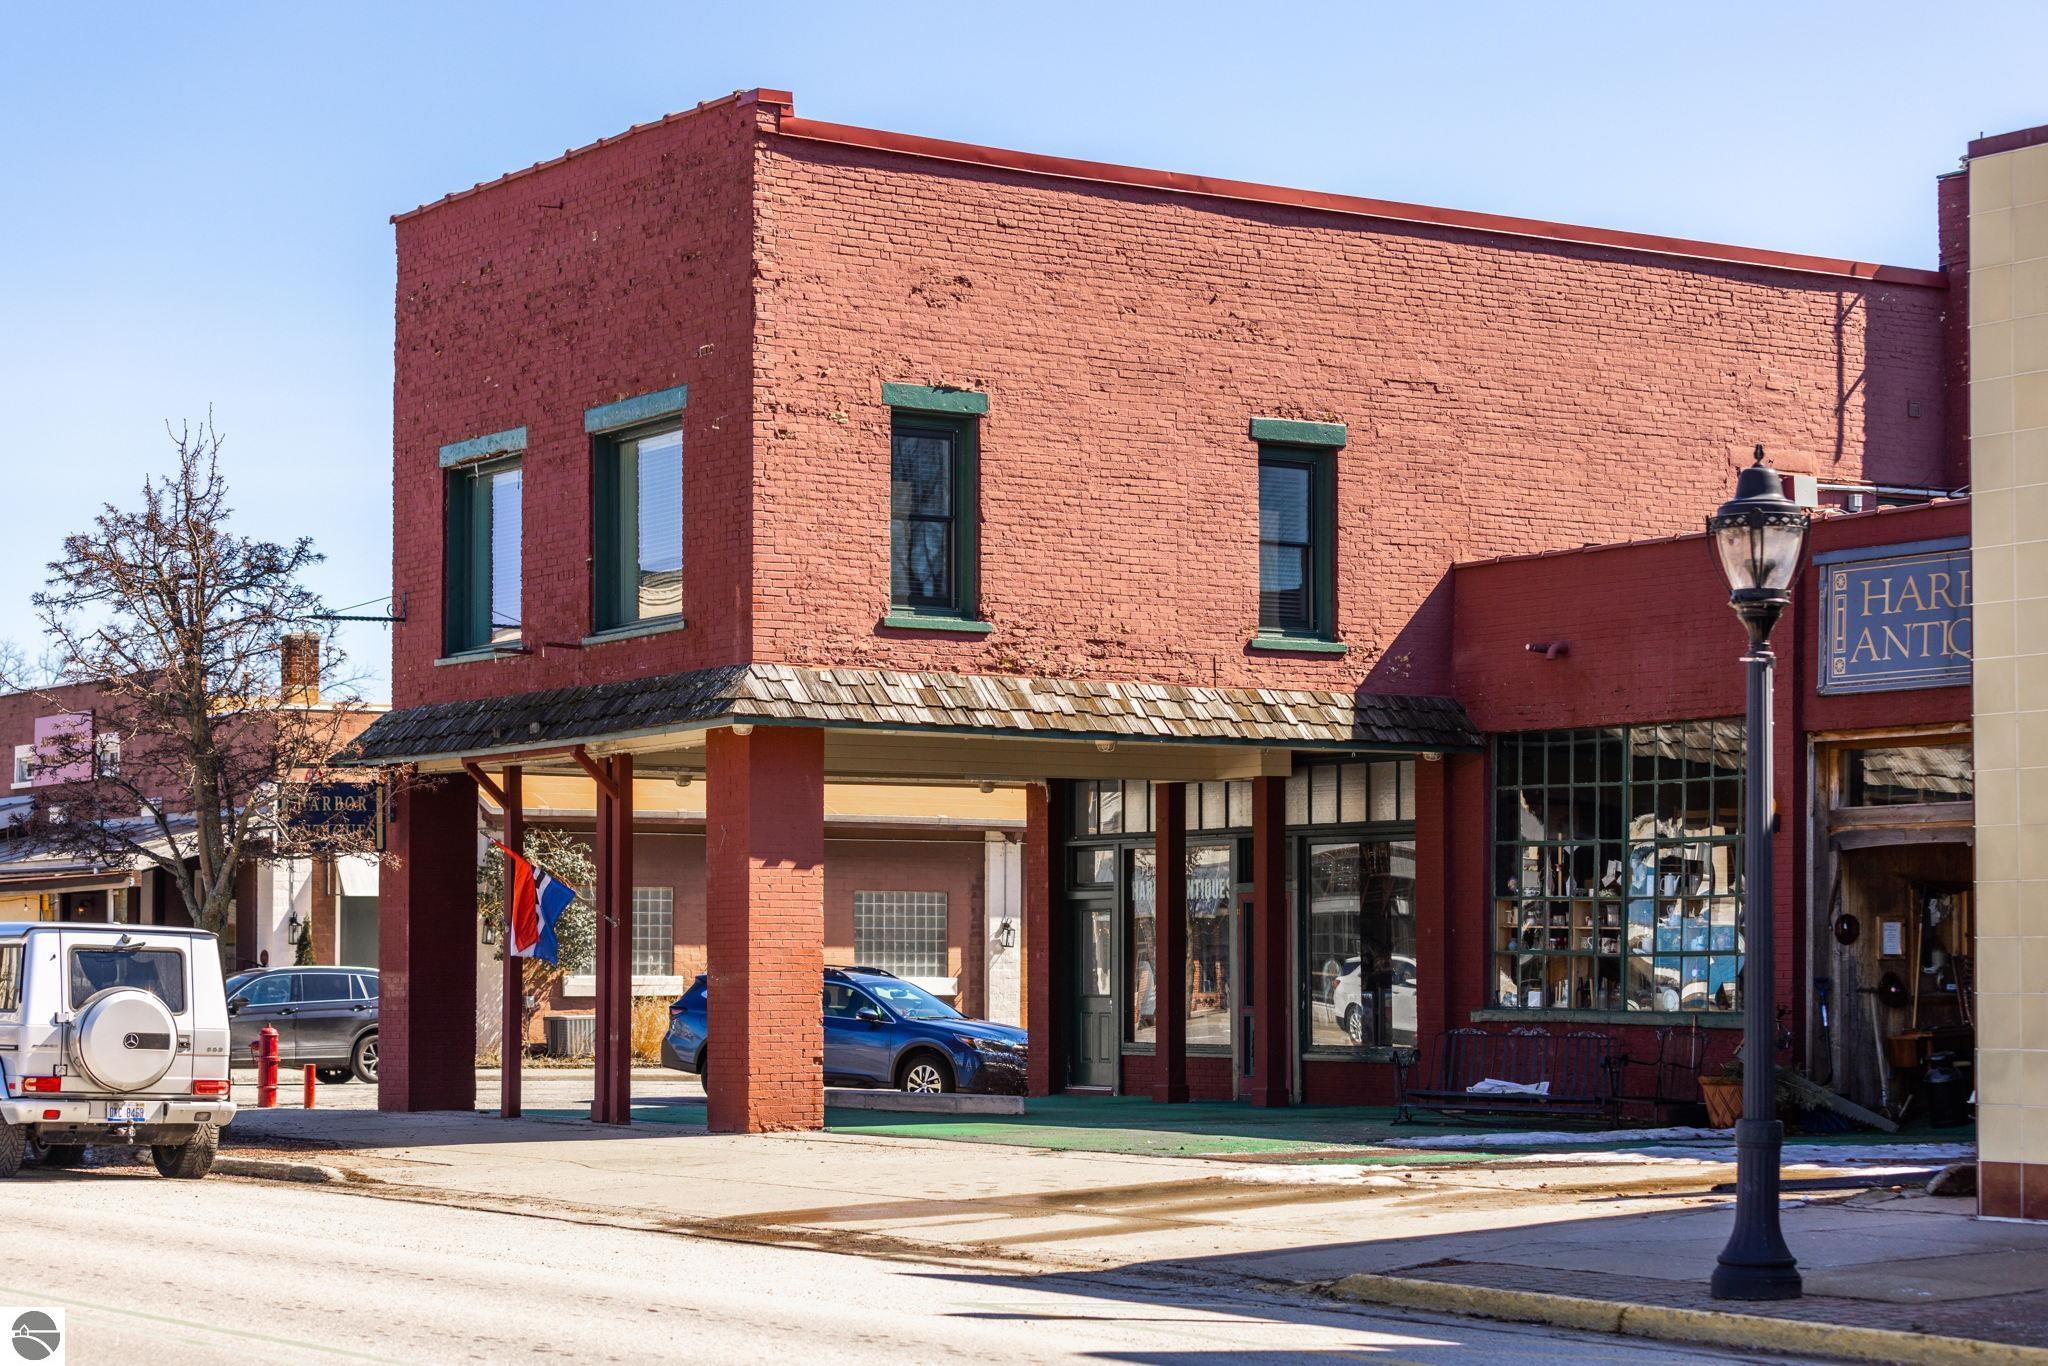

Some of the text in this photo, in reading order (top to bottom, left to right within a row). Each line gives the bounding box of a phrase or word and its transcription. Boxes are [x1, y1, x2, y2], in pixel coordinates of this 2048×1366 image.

[1850, 617, 1971, 663] ANTIQ
[292, 823, 376, 840] NTIQUES
[1132, 878, 1230, 903] HAR NTIQUES
